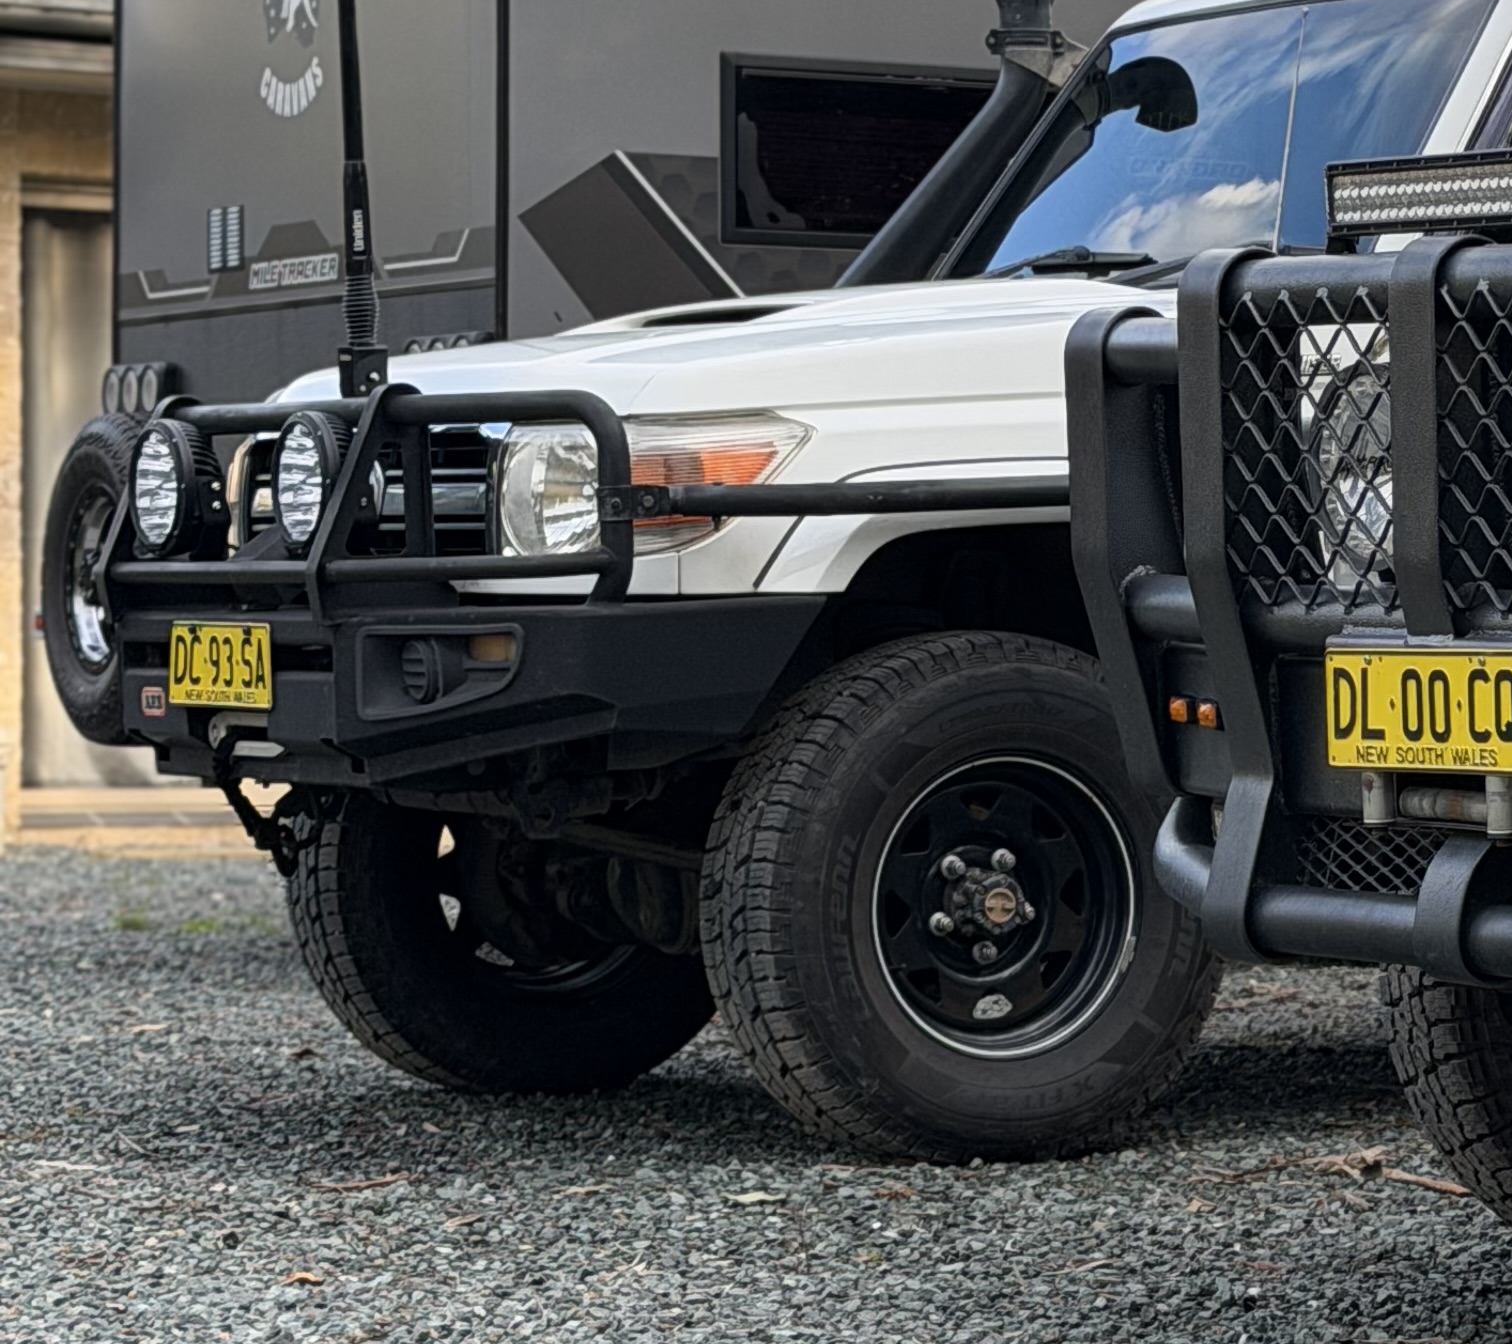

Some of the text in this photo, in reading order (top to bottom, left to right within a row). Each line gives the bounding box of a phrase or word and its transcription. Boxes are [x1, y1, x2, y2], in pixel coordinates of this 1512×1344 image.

[259, 55, 324, 118] CARAVANS
[352, 209, 365, 252] Uniden
[248, 253, 339, 290] MILE TRACKER
[1355, 745, 1499, 768] NEW SOUTH WALES
